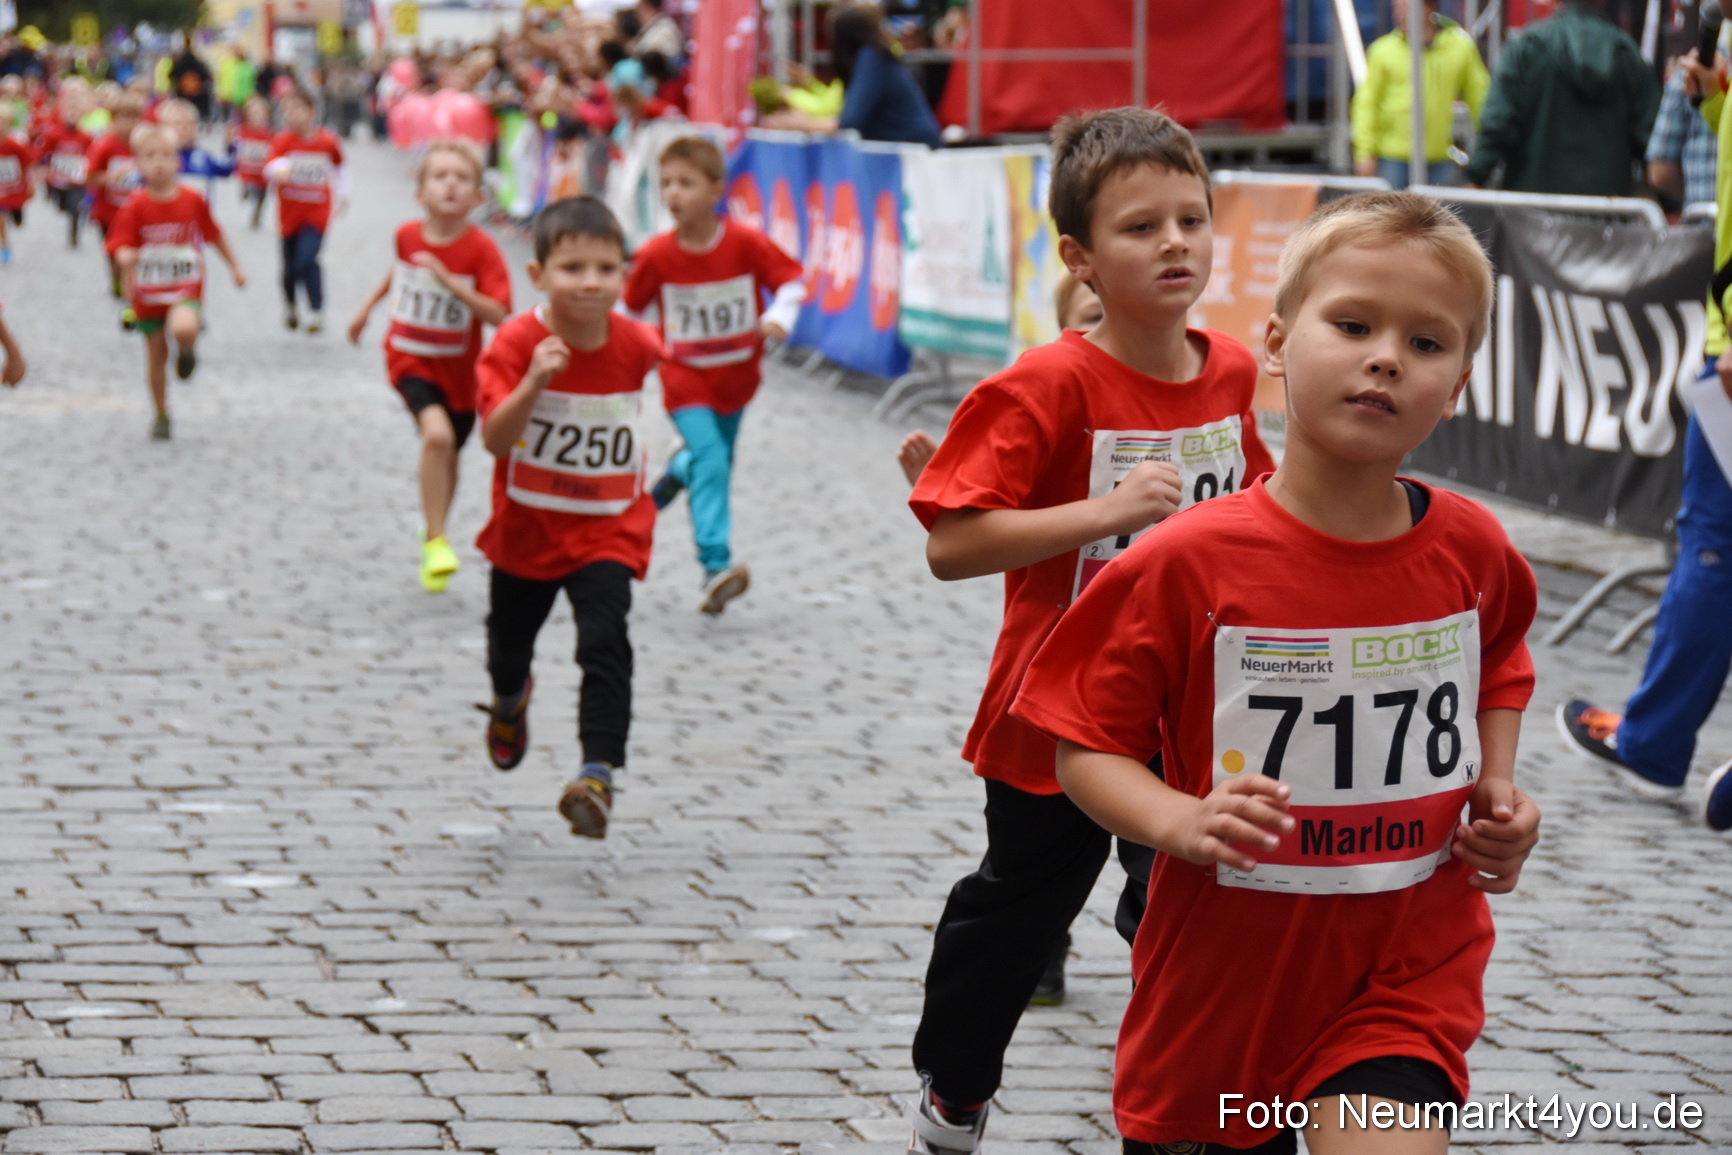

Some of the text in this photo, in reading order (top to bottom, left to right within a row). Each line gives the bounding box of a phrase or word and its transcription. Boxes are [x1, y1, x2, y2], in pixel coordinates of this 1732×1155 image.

[674, 297, 747, 334] 7197
[529, 416, 634, 469] 7250
[1110, 452, 1172, 464] NeuerMarkt
[1352, 622, 1460, 668] BOCK
[1240, 657, 1334, 674] NeuerMarkt
[1352, 667, 1391, 680] inspired
[1394, 665, 1405, 677] by
[1407, 662, 1432, 675] smart
[1248, 681, 1462, 790] 7178
[1300, 815, 1424, 856] Marlon
